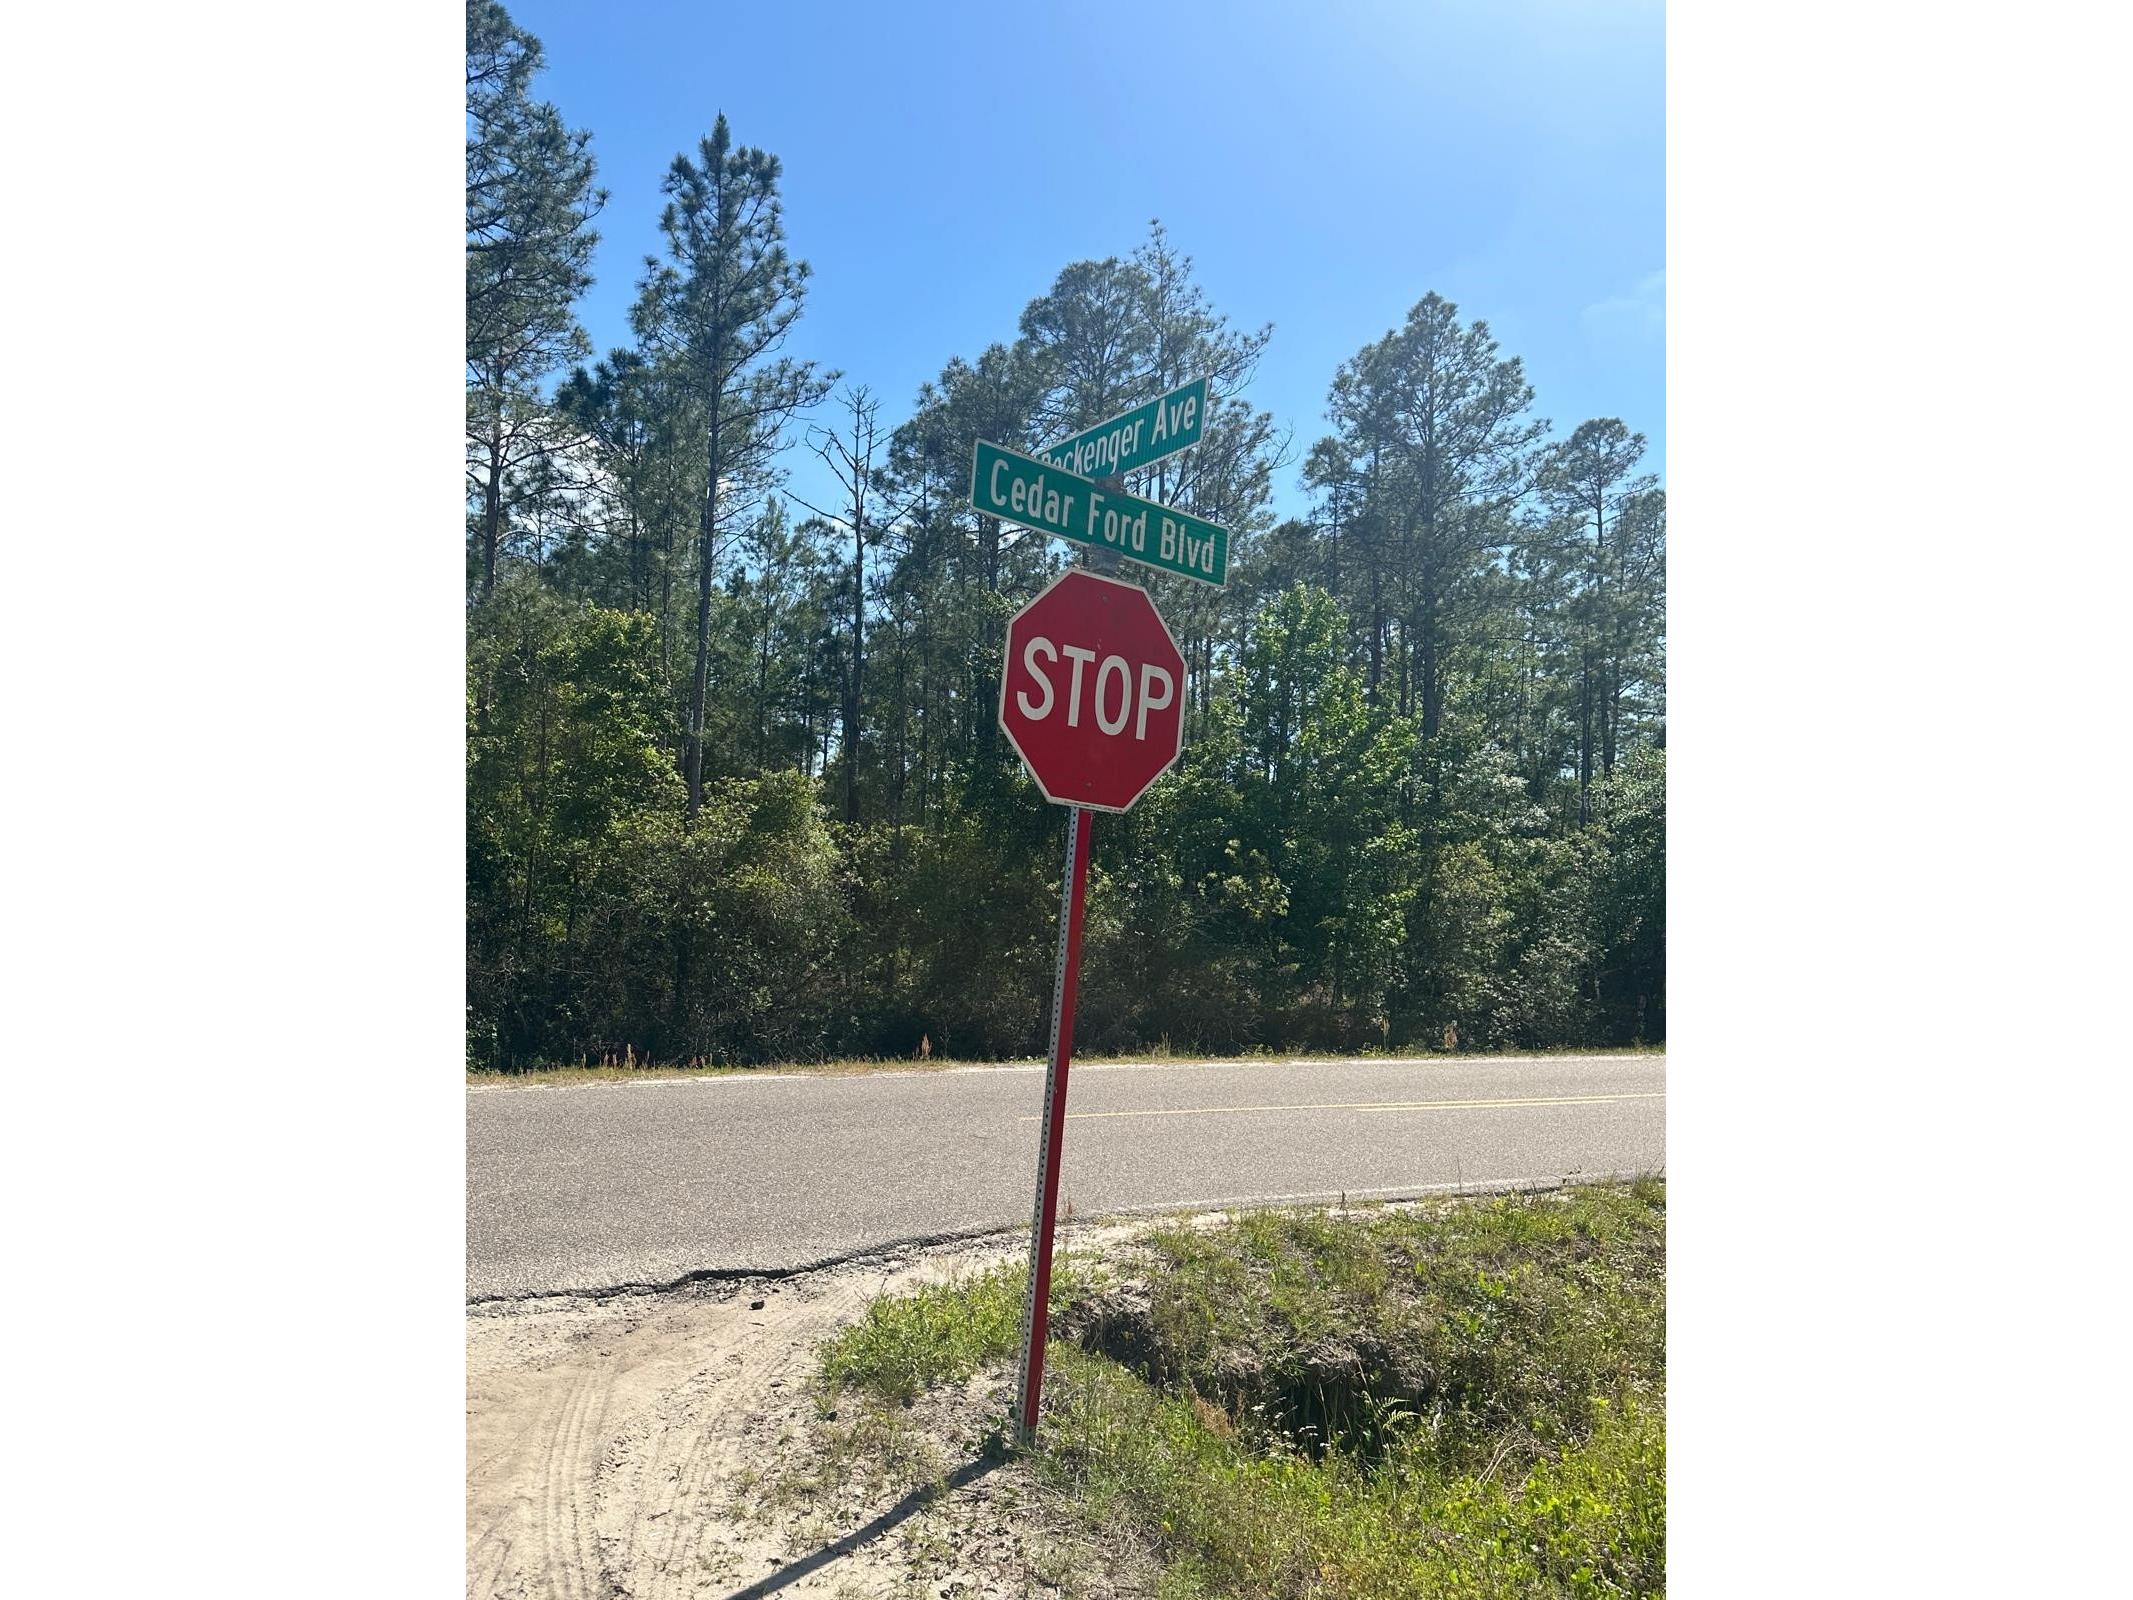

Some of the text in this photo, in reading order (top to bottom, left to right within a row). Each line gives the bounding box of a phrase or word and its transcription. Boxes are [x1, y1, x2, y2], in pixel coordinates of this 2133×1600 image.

[1151, 396, 1197, 446] Ave
[990, 458, 1216, 574] Cedar Ford Blvd
[1016, 636, 1174, 741] STOP
